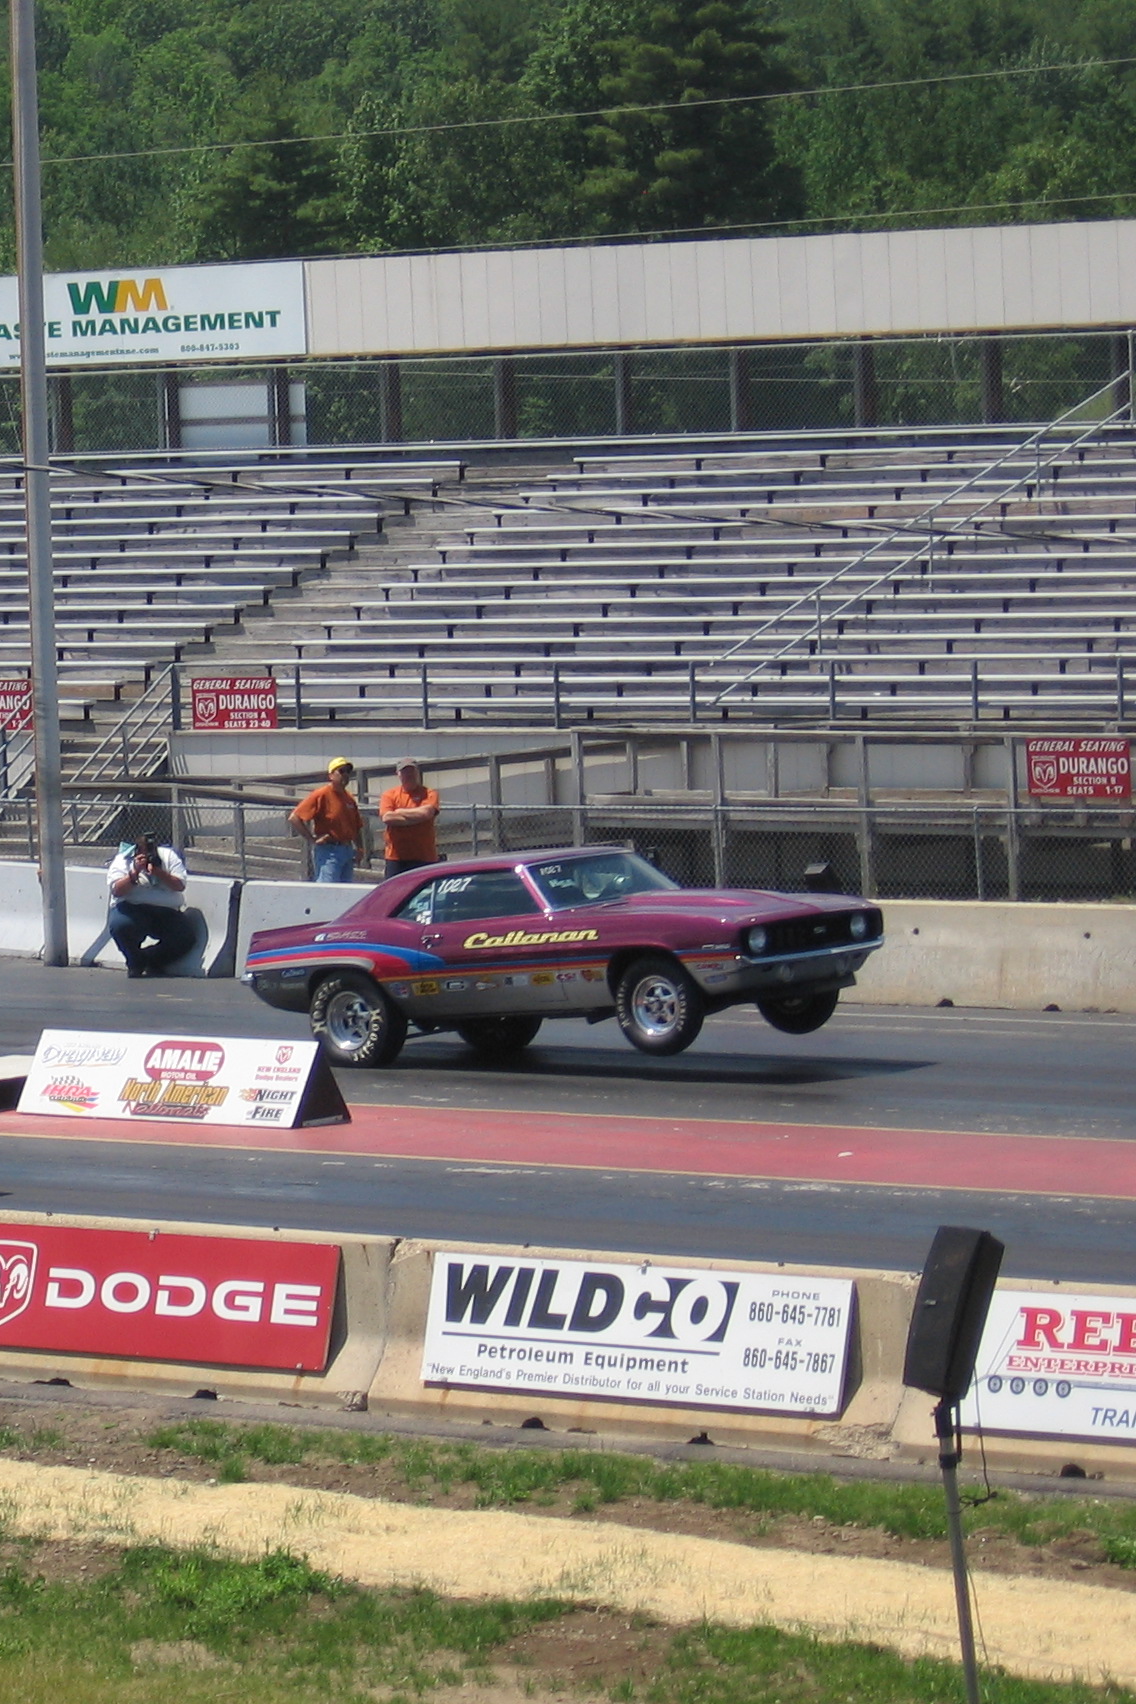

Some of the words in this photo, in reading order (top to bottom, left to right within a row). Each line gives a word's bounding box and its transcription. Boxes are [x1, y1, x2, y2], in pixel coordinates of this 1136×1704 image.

[67, 278, 168, 315] WM
[72, 310, 281, 338] MANAGEMENT
[193, 680, 231, 690] GENERAL
[234, 679, 272, 689] SEATING
[219, 694, 275, 710] DURANGO
[224, 720, 246, 728] SEATS
[230, 711, 258, 719] SECTION
[260, 711, 267, 719] A
[1029, 741, 1075, 752] GENERAL
[1078, 740, 1126, 752] SEATING
[1059, 757, 1129, 775] DURANGO
[1073, 776, 1107, 785] SECTION
[1067, 786, 1094, 795] SEATS
[1105, 786, 1124, 795] 1-17
[437, 877, 472, 894] 1027
[463, 928, 599, 950] Callanan
[42, 1044, 128, 1067] Dragway
[146, 1048, 223, 1071] AMALIE
[160, 1071, 185, 1080] MOTOR
[186, 1072, 197, 1080] OIL
[273, 1066, 301, 1074] ENGLAND
[118, 1077, 162, 1102] North
[159, 1080, 229, 1106] American
[253, 1089, 298, 1102] NIGHT
[122, 1100, 211, 1118] Nationals
[45, 1267, 322, 1326] DODGE
[444, 1263, 741, 1343] WILDCO
[772, 1289, 821, 1301] PHONE
[748, 1302, 842, 1328] 860-645-7781
[777, 1337, 803, 1347] FAX
[477, 1343, 574, 1365] Petroleum
[583, 1351, 689, 1374] Equipment
[743, 1347, 836, 1374] 860-645-7867
[459, 1364, 512, 1381] England's
[516, 1369, 559, 1384] Premier
[562, 1373, 622, 1389] Distributor
[626, 1378, 643, 1391] for
[647, 1380, 661, 1392] all
[665, 1384, 690, 1396] your
[695, 1383, 738, 1399] Service
[743, 1387, 785, 1403] Station
[1092, 1407, 1136, 1428] TRA
